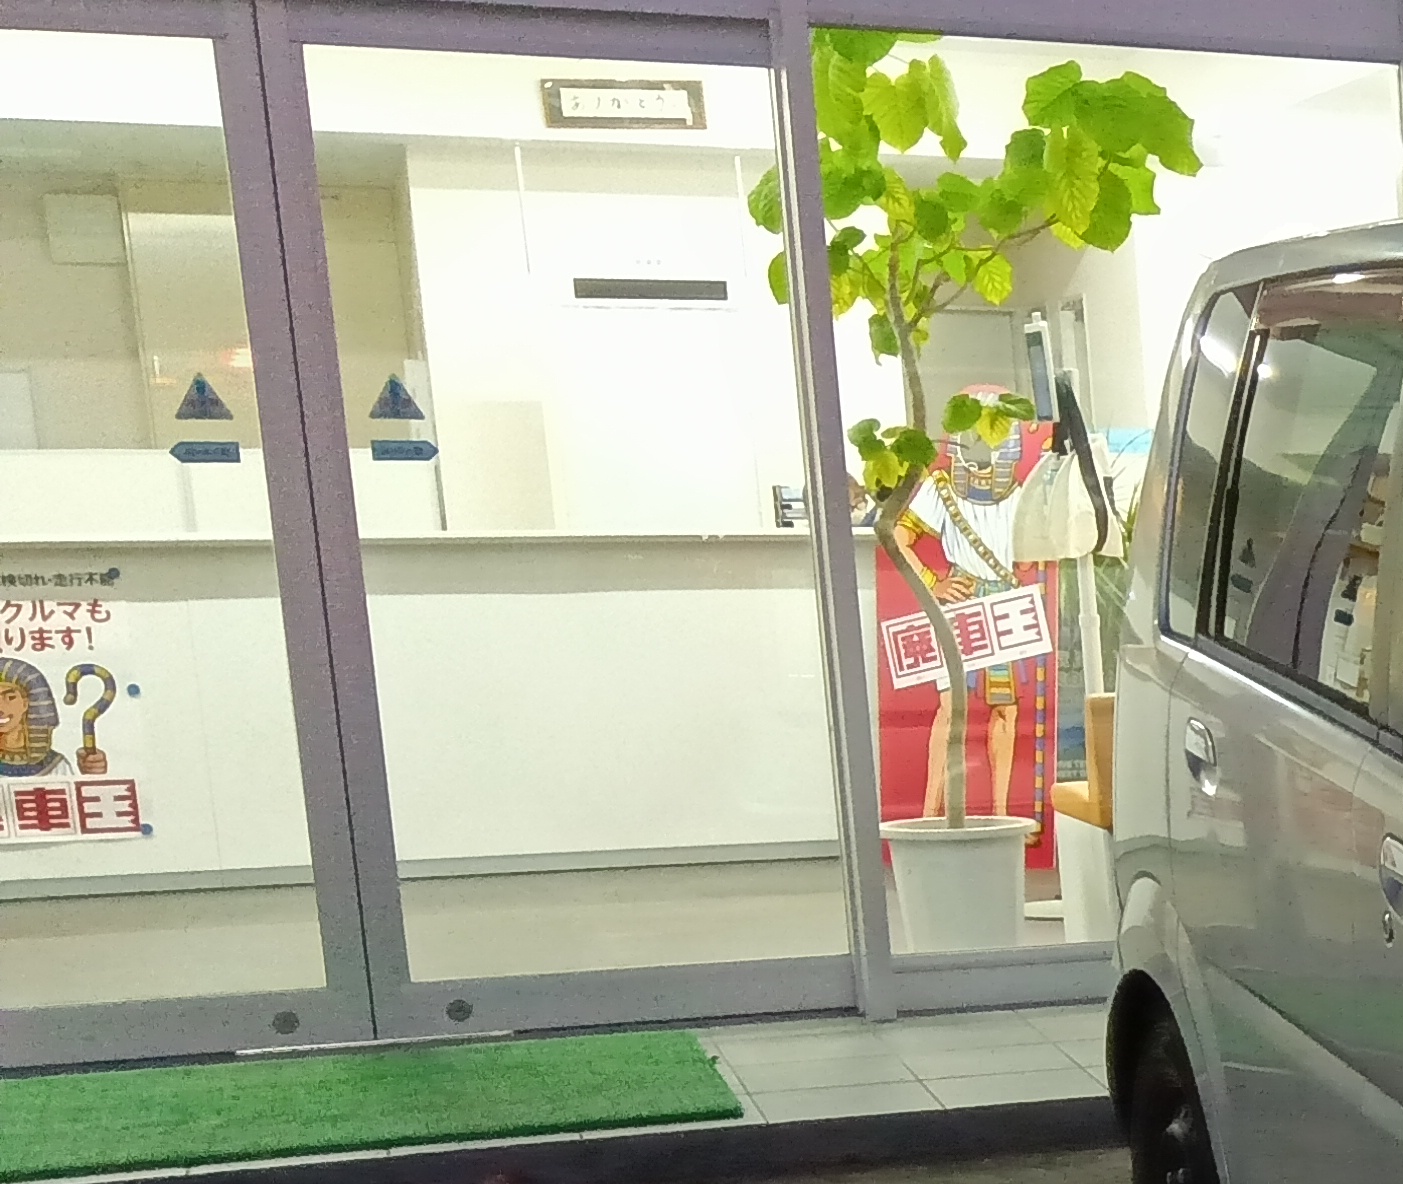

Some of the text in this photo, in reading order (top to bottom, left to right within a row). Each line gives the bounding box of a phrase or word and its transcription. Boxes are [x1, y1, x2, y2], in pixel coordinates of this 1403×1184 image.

[0, 598, 111, 624] クルマも
[0, 626, 94, 653] ります!
[0, 779, 141, 834] 車王
